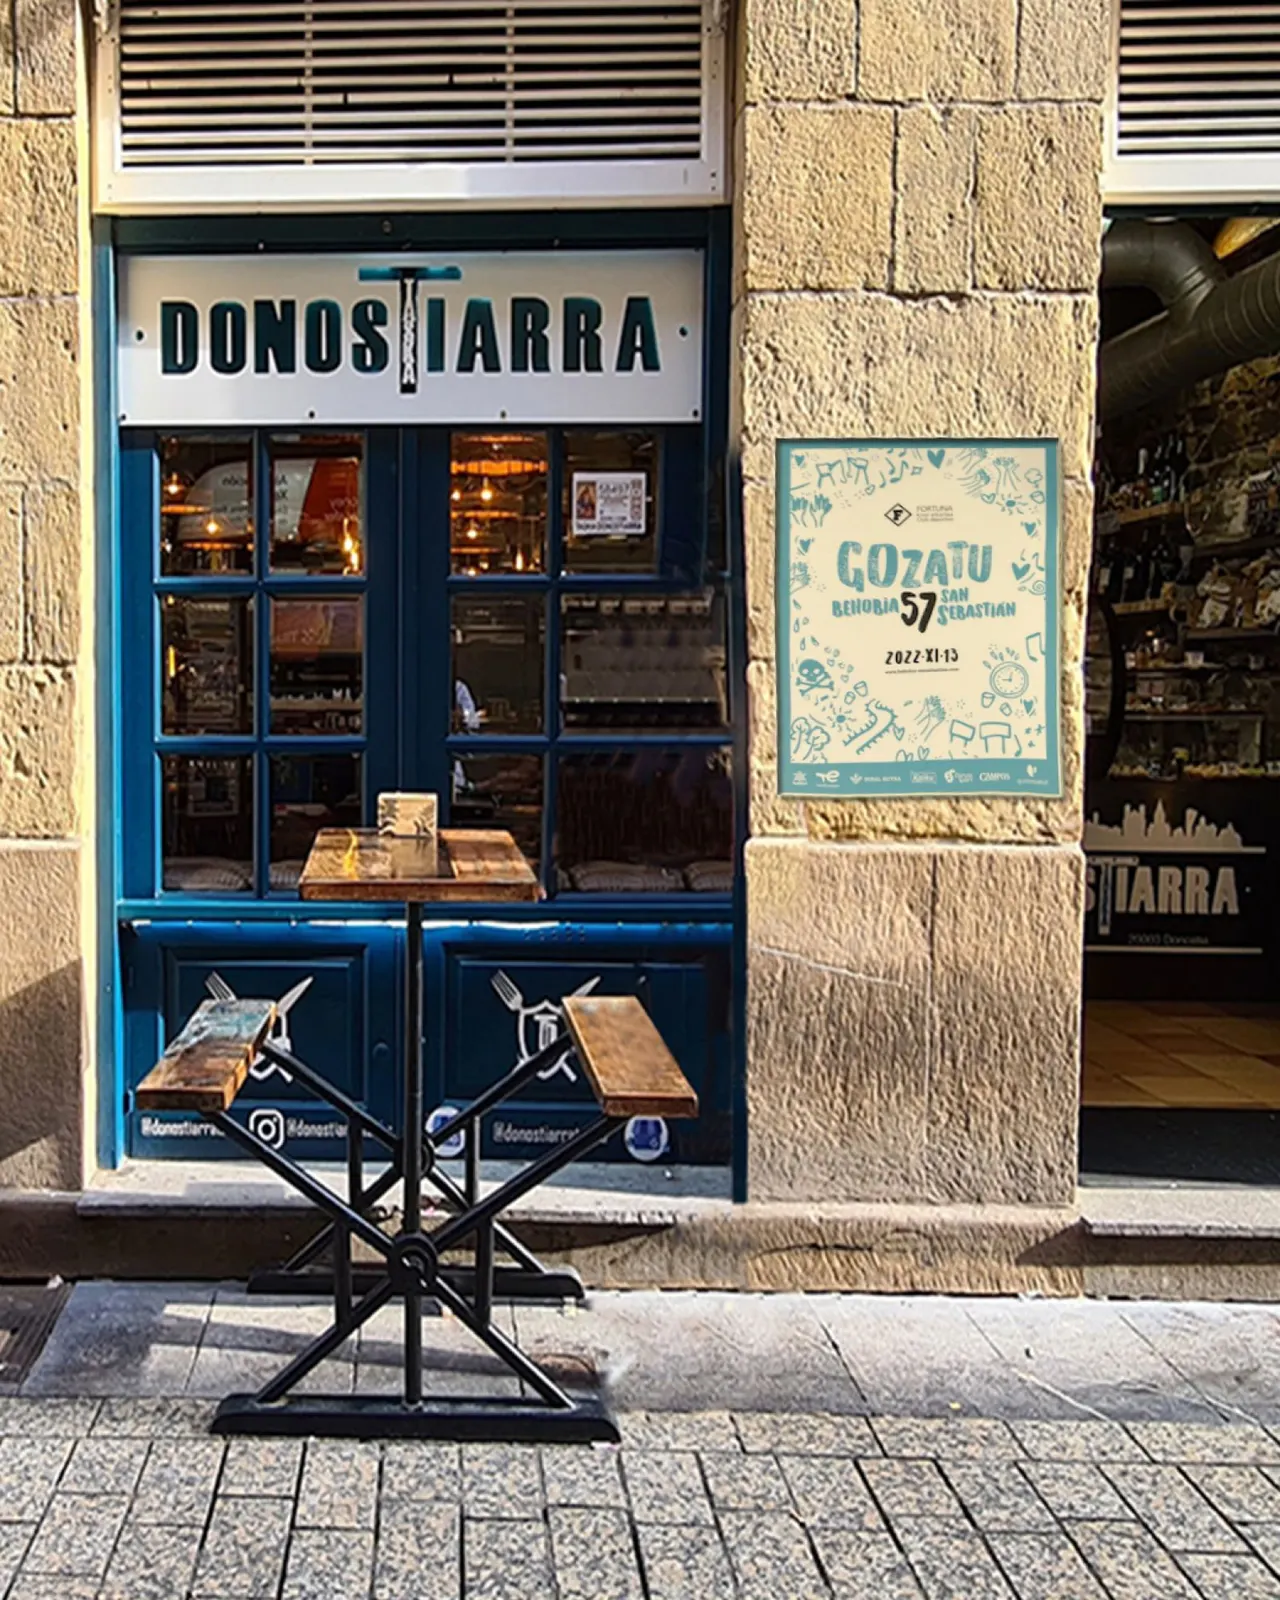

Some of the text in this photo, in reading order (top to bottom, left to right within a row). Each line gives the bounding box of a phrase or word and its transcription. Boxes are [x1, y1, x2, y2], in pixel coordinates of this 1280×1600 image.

[160, 265, 661, 394] DONOSTIARRA
[837, 540, 993, 592] GOZATU
[832, 587, 969, 633] BEHOBIA 57 SAN
